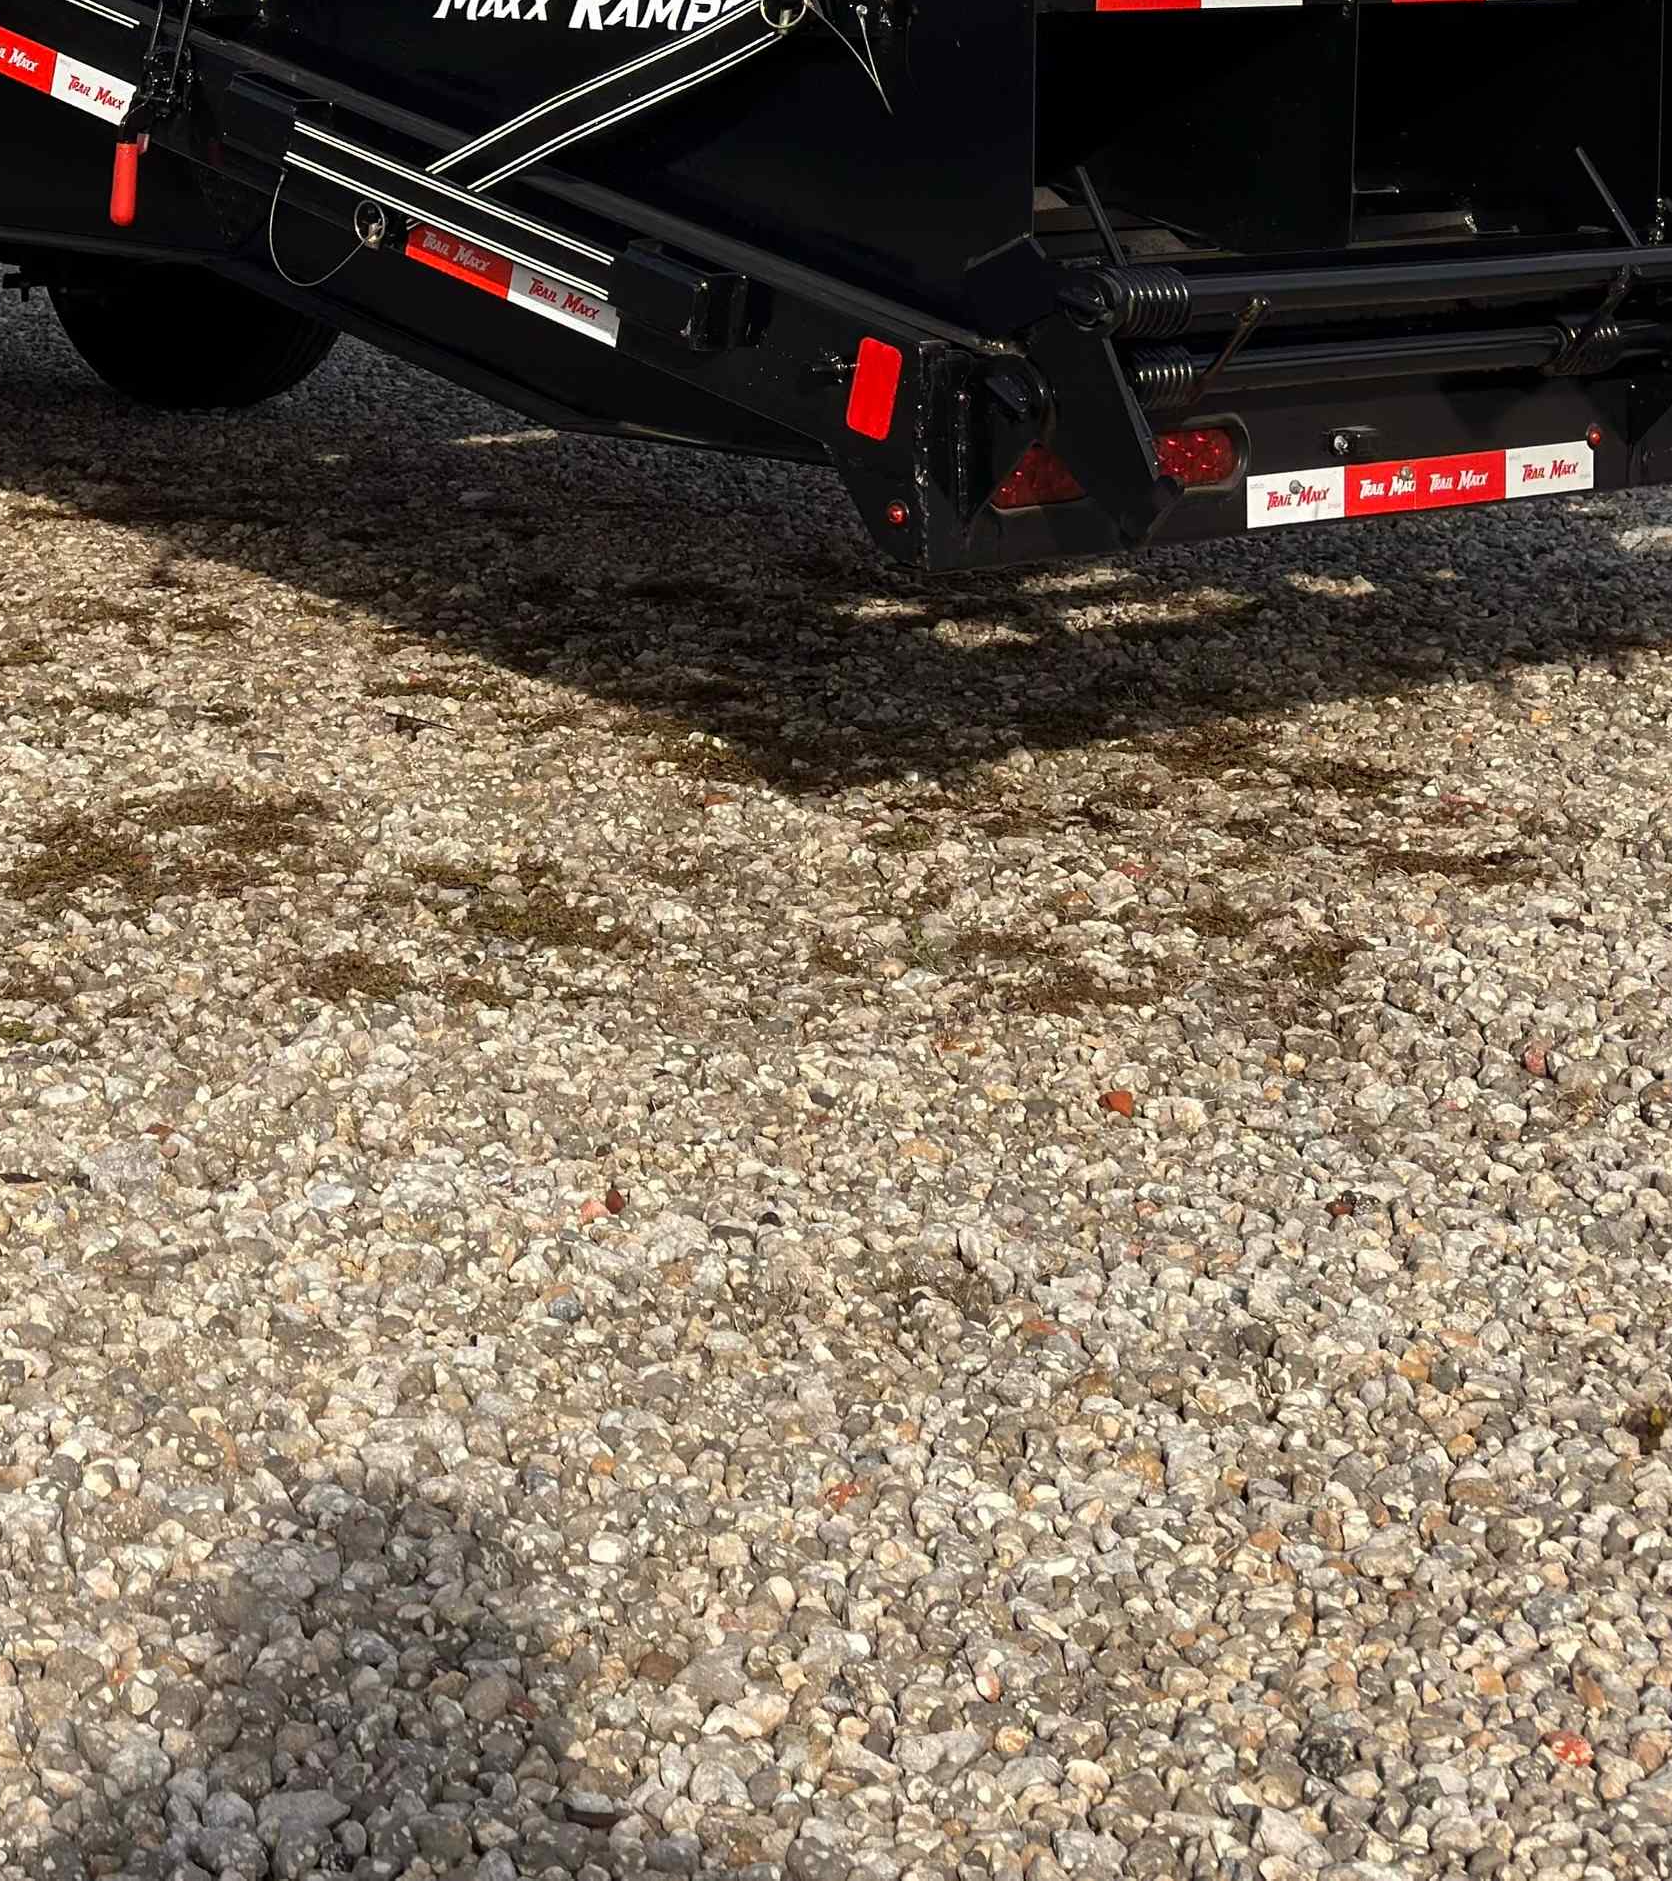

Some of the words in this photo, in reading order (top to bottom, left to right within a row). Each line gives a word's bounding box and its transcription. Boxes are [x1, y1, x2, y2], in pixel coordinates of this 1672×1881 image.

[8, 47, 38, 71] MAXX
[68, 74, 91, 97] TRAIL
[94, 87, 125, 110] MAXX
[423, 231, 450, 256] TRAIL
[453, 244, 490, 272] MAXX
[528, 278, 557, 303] TRAIL
[561, 292, 600, 320] MAXX
[1430, 472, 1453, 493] TRAIL
[1457, 470, 1488, 490] MAXX
[1522, 464, 1545, 481] TRAIL
[1550, 460, 1579, 479] MAXX
[1266, 490, 1292, 511] TRAIL
[1298, 486, 1330, 504] MAXX
[1360, 479, 1384, 499] TRAIL
